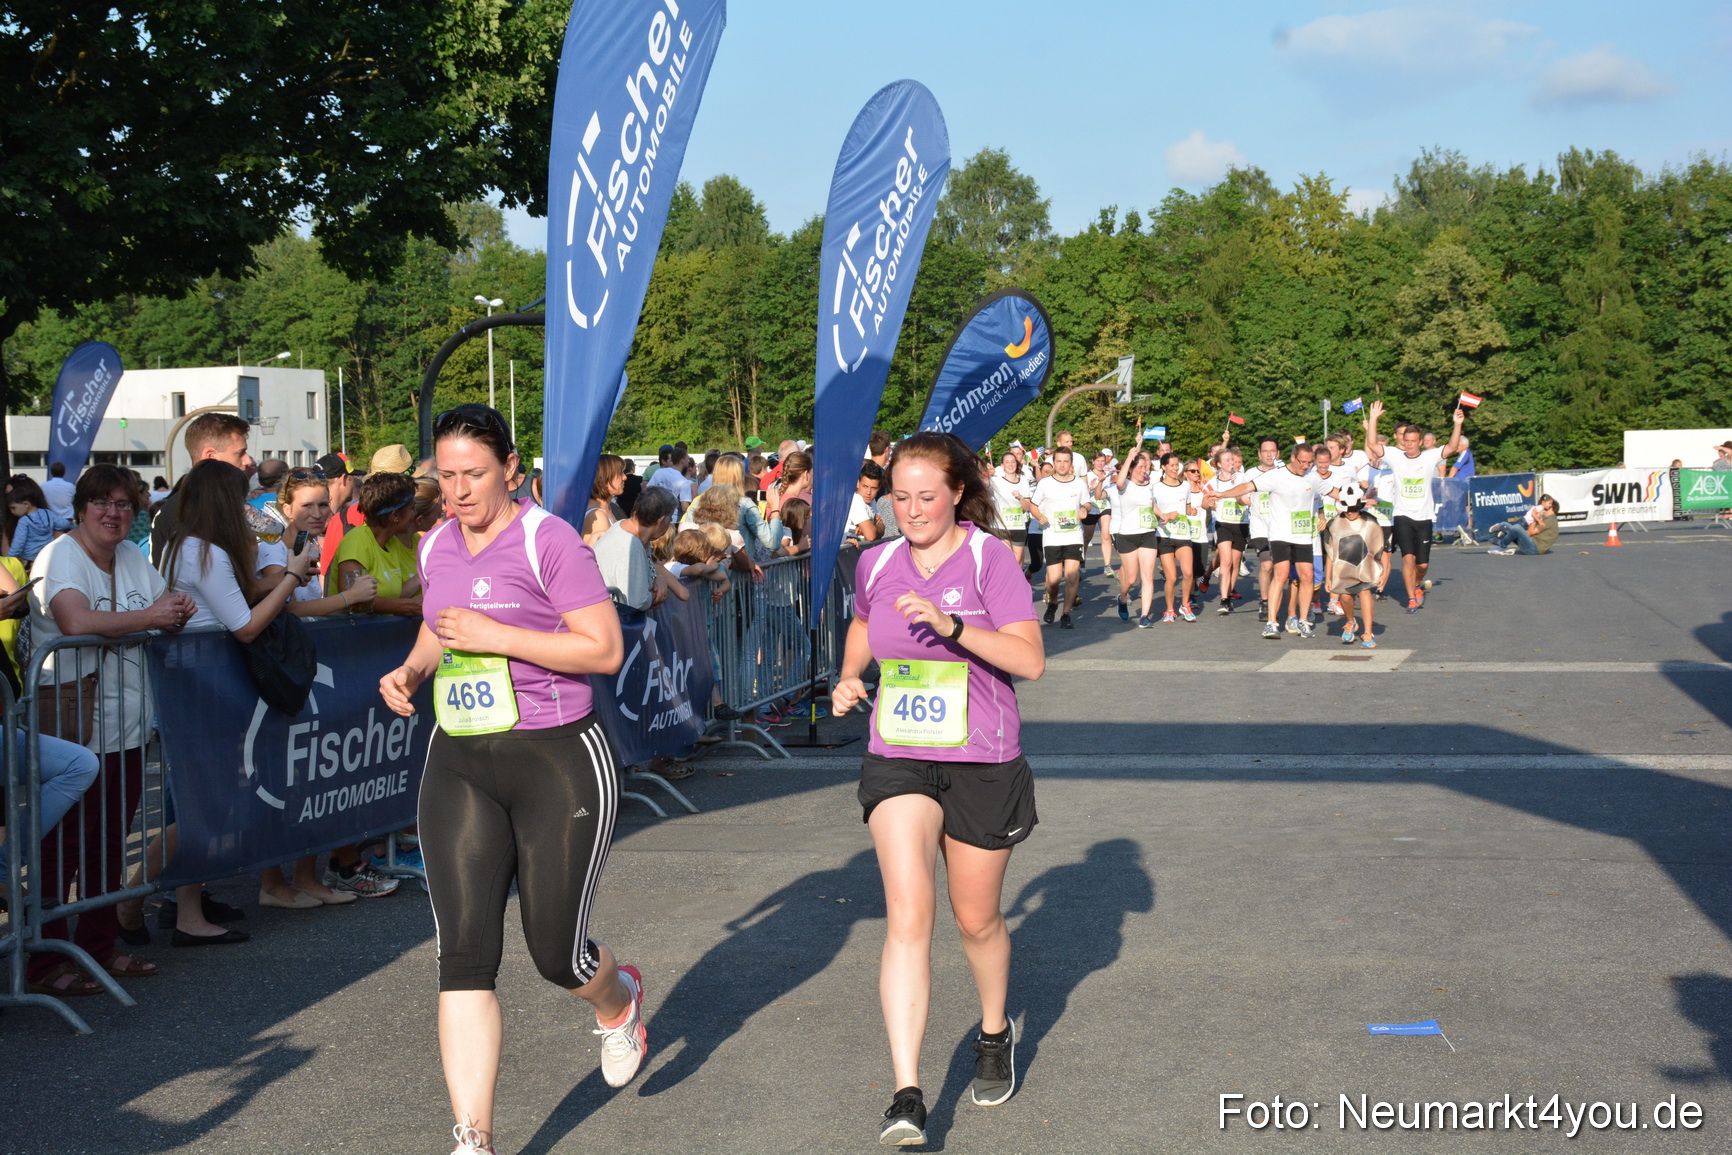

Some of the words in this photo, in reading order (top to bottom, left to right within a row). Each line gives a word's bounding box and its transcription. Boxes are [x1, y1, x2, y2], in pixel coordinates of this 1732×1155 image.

[616, 19, 694, 273] AUTOMOBILE
[849, 126, 918, 340] Fischer
[873, 163, 929, 336] AUTOMOBILE
[67, 358, 108, 435] Fischer
[980, 389, 1004, 415] Druck
[1018, 351, 1047, 383] Medien
[82, 371, 113, 433] AUTOMOBILE
[1474, 491, 1523, 507] Frischmann
[1592, 481, 1642, 506] swn
[1689, 475, 1729, 496] AOK
[1005, 514, 1021, 522] 1547
[1168, 521, 1186, 529] 1519
[1293, 519, 1311, 528] 1538
[469, 602, 521, 611] Fertigteilwerke
[446, 681, 495, 711] 468
[893, 694, 947, 723] 469
[895, 727, 923, 735] Alexandra
[286, 706, 419, 788] Fischer
[298, 769, 409, 823] AUTOMOBILE
